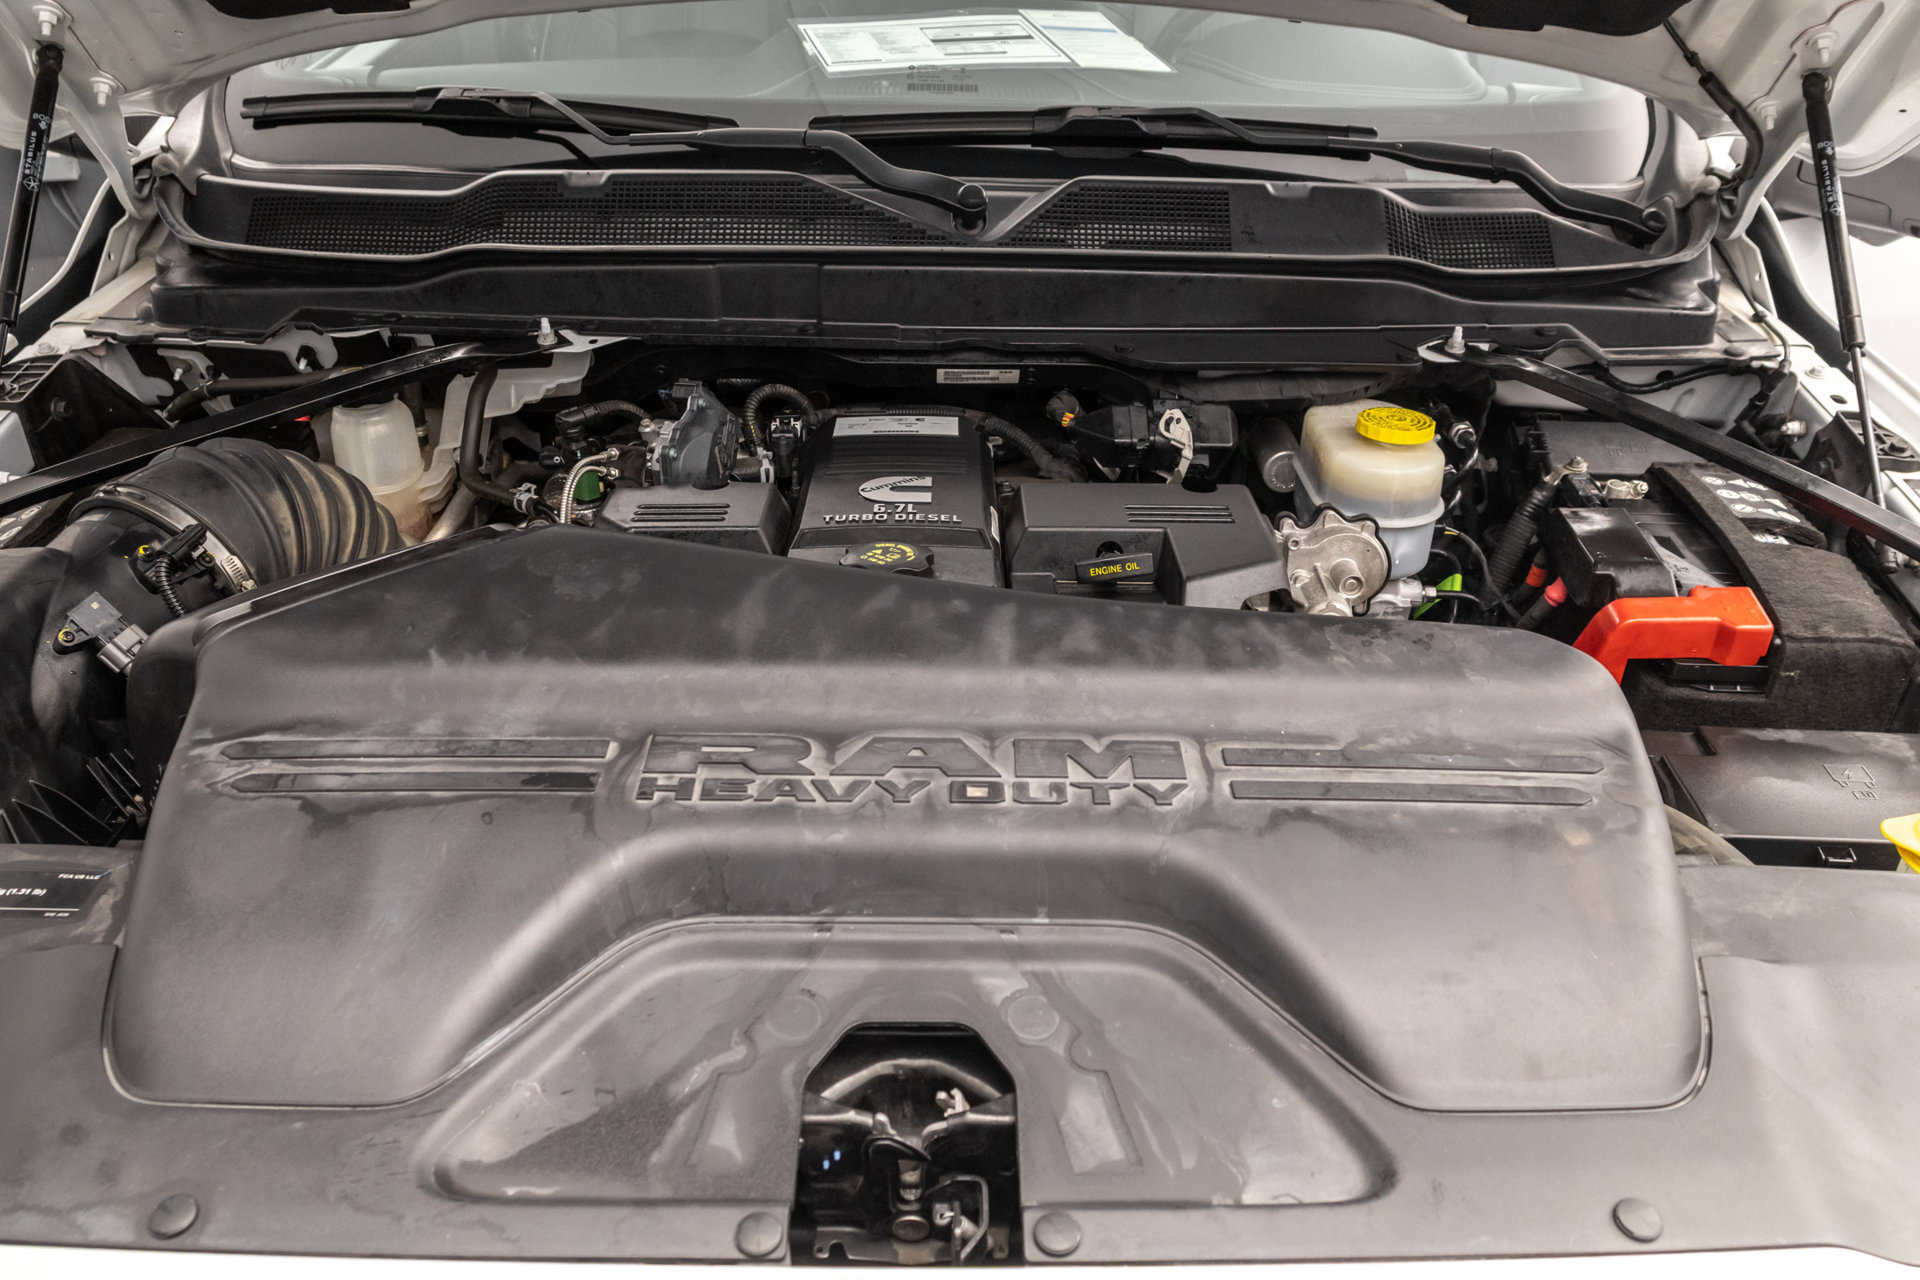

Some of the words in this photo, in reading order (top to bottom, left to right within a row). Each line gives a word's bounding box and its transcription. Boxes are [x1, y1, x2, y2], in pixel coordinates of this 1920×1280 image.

[25, 131, 37, 174] STABILUS
[1821, 159, 1834, 203] STABILUS
[860, 475, 926, 493] Cummins
[823, 513, 888, 524] TURBO
[894, 513, 963, 524] DIESEL
[873, 503, 917, 514] 6.7L
[1089, 564, 1123, 577] ENGINE
[1125, 562, 1140, 572] OIL
[641, 734, 1188, 780] RAM
[635, 777, 932, 803] HEAVY
[949, 780, 1189, 806] DUTY
